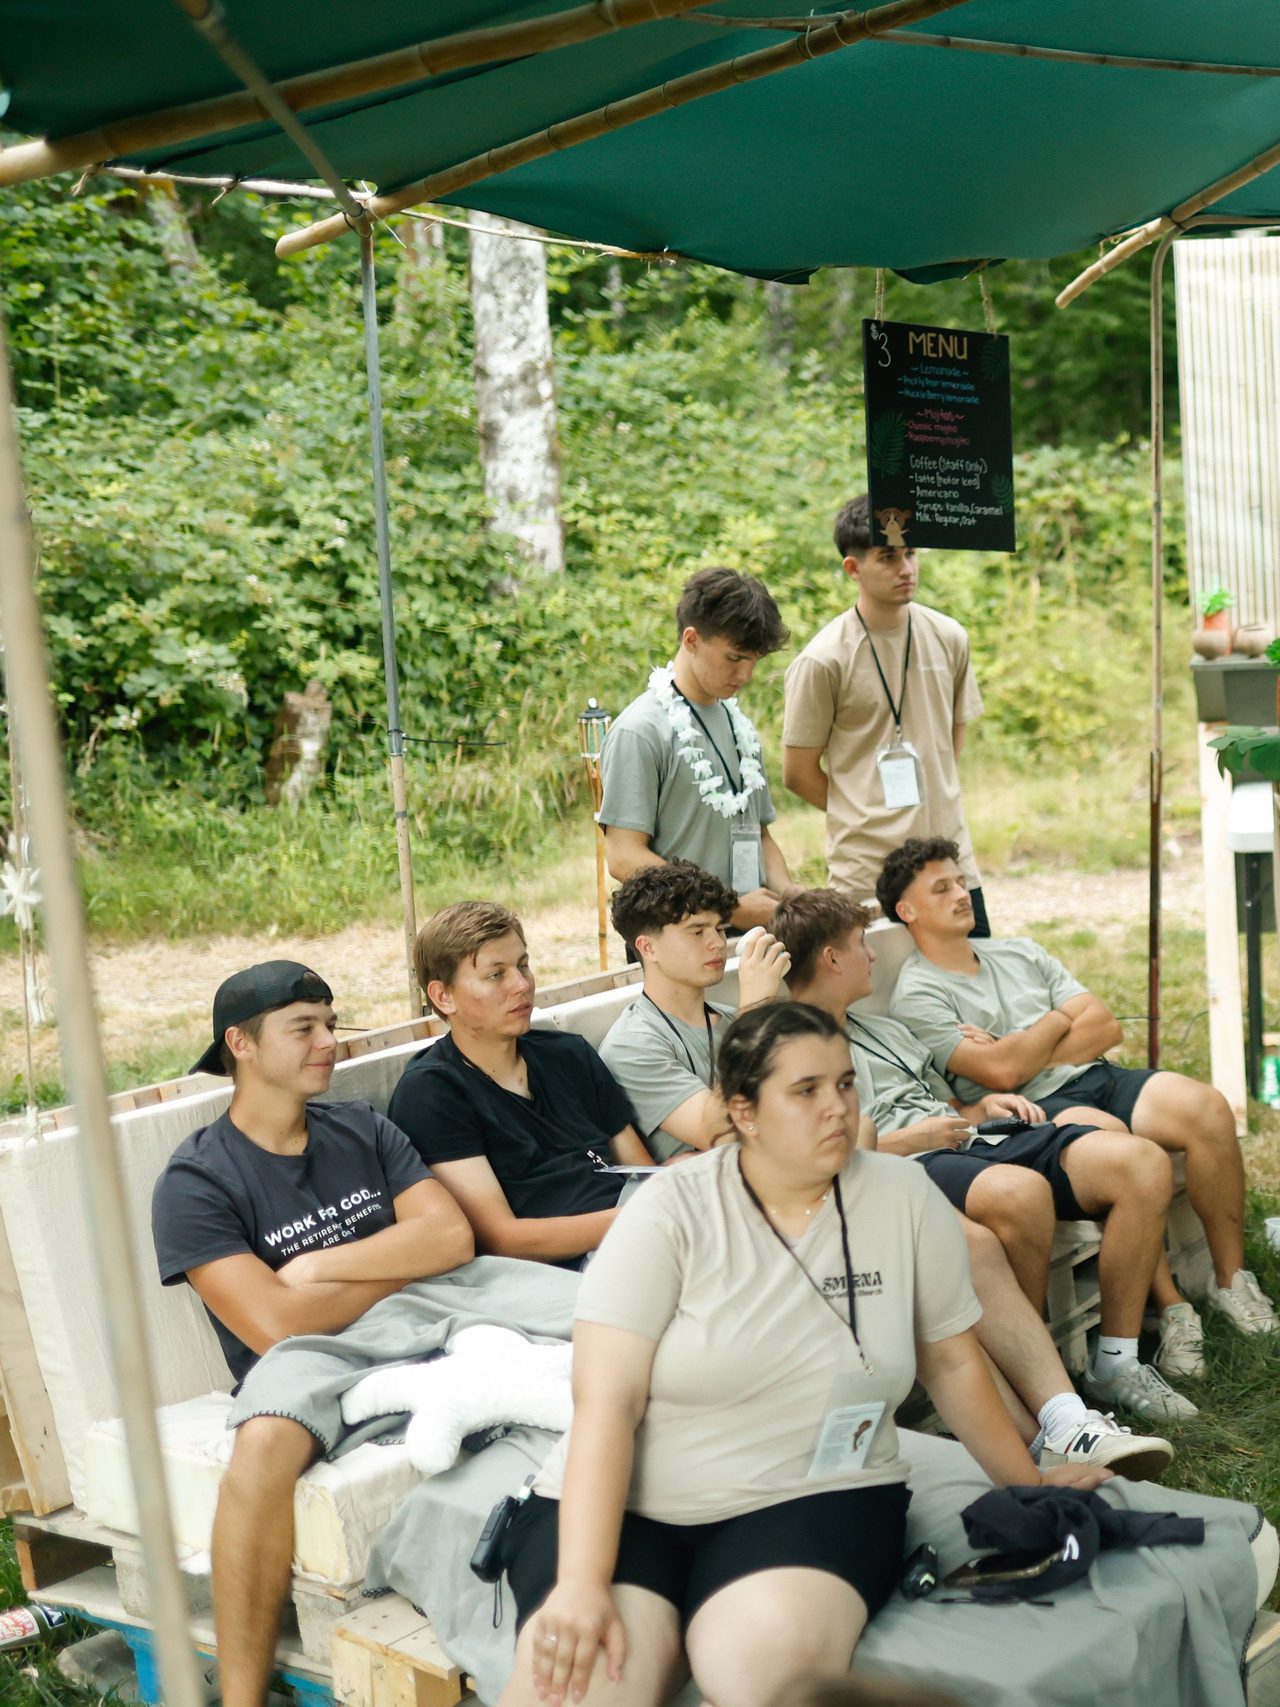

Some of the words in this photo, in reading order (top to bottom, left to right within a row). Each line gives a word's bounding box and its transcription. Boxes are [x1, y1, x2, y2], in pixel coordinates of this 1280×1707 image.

[908, 331, 968, 360] MENU
[920, 363, 962, 377] Lemonade
[909, 454, 938, 470] Coffee
[915, 472, 936, 484] Latte
[916, 485, 960, 499] Americano
[264, 1214, 317, 1248] WORK
[340, 1189, 382, 1211] GOD...
[322, 1234, 340, 1249] ARE
[280, 1242, 301, 1257] THE
[822, 1271, 883, 1293] SMRNA
[1073, 1432, 1100, 1454] N
